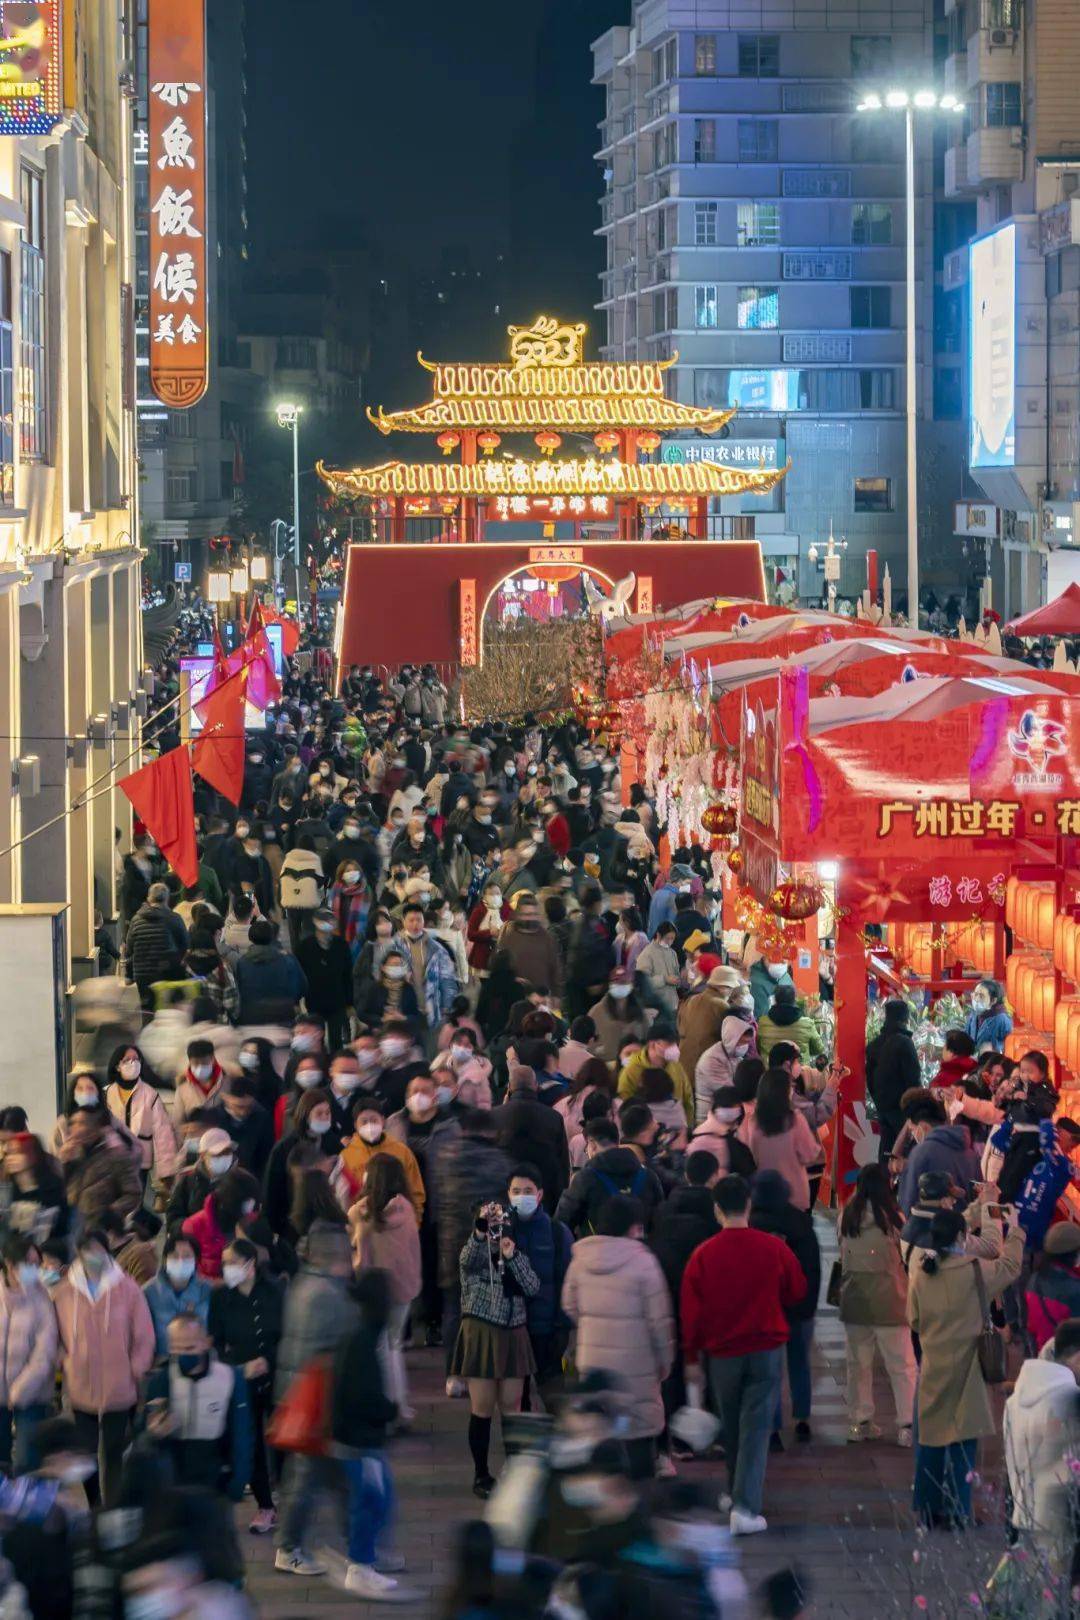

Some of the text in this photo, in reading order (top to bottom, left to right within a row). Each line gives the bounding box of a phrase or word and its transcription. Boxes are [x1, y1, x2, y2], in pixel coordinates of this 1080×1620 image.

[153, 313, 202, 345] 美食
[686, 446, 776, 462] 中国农业银行
[178, 565, 187, 577] P
